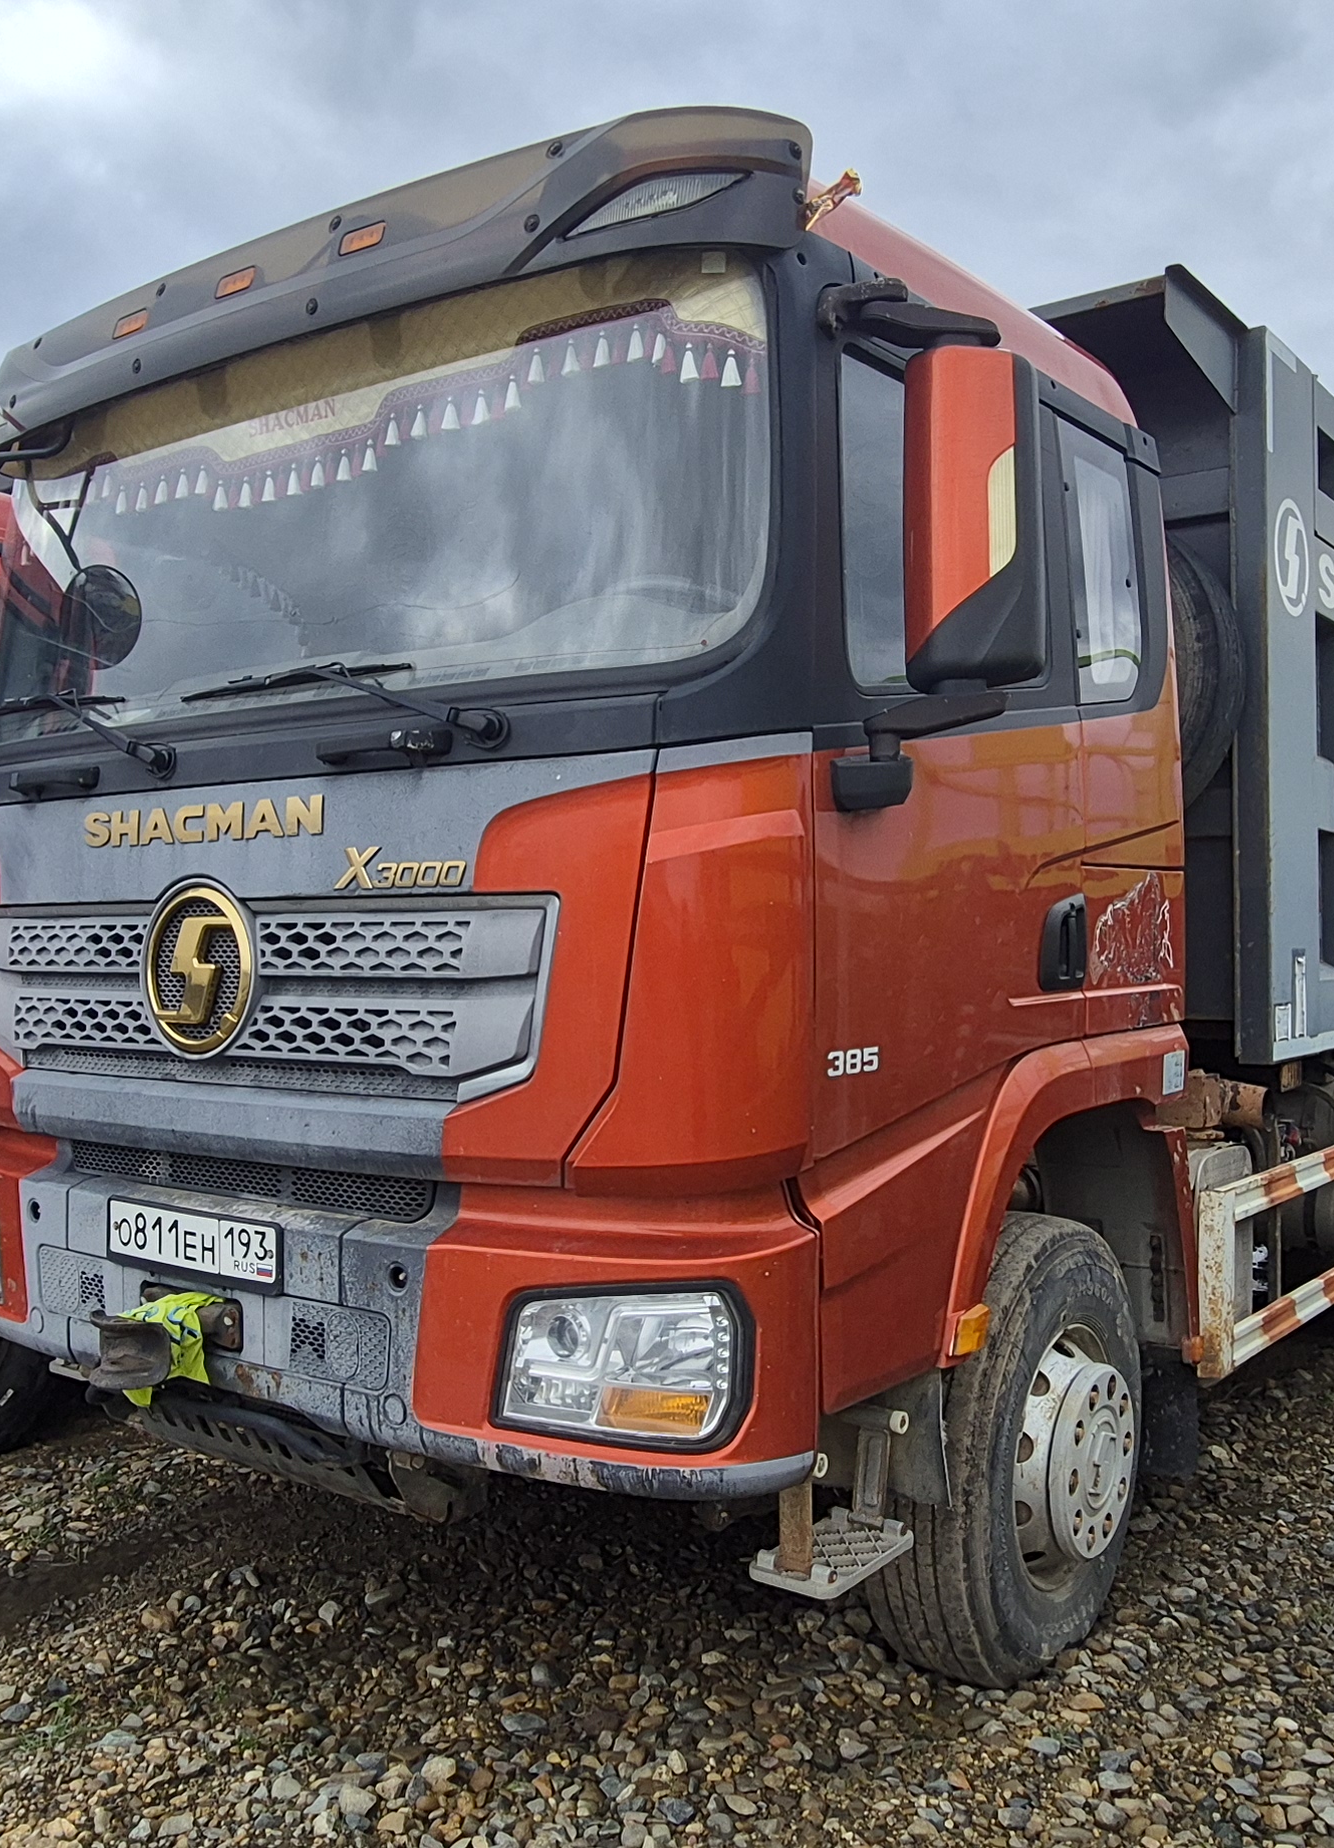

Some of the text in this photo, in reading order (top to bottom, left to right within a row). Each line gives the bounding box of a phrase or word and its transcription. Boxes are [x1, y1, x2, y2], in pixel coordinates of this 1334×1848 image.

[249, 398, 336, 438] SHACMAN
[83, 794, 325, 847] SHACMAN
[334, 846, 466, 890] X3000
[827, 1046, 879, 1078] 385
[223, 1226, 268, 1261] 193
[233, 1260, 256, 1274] RUS
